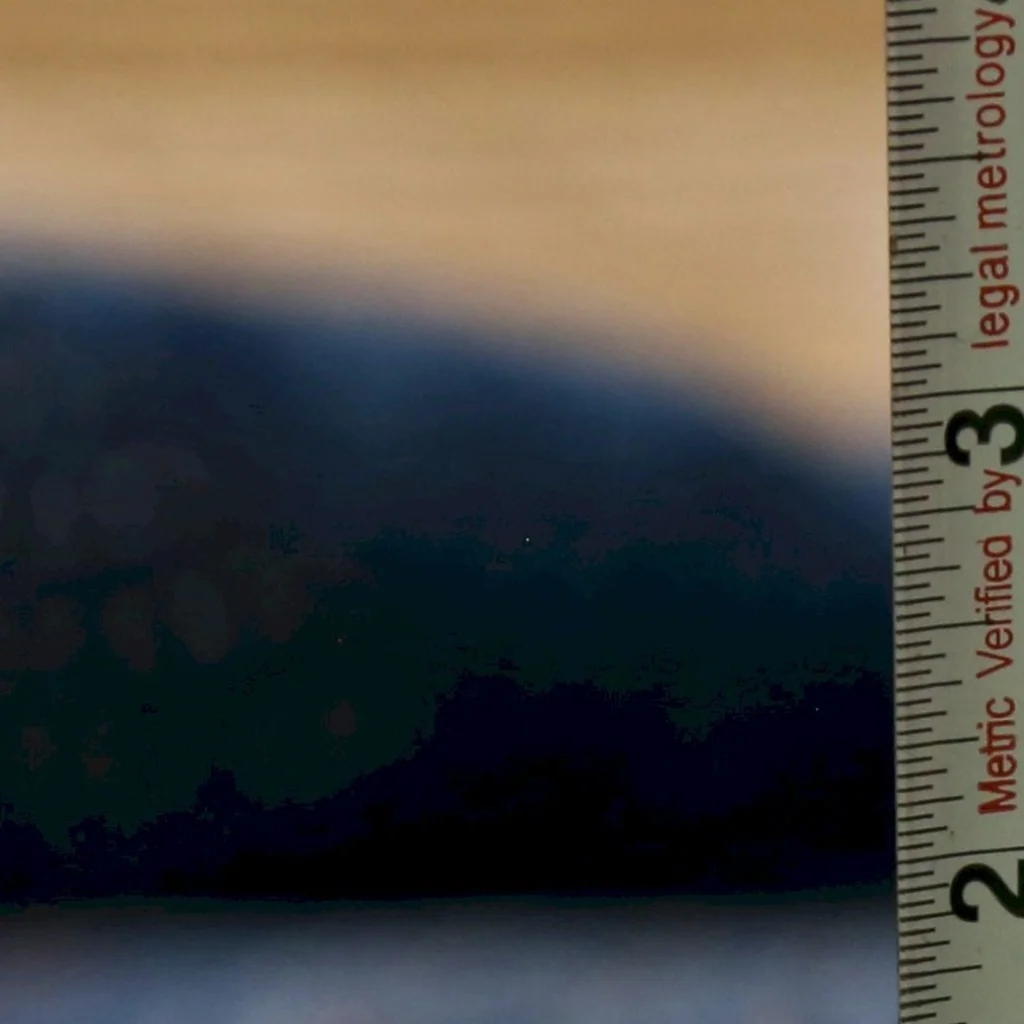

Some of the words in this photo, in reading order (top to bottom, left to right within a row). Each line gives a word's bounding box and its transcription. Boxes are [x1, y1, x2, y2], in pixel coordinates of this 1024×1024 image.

[965, 7, 1015, 230] metrology
[970, 243, 1020, 350] legal
[972, 468, 1022, 515] by
[973, 534, 1014, 679] Verified
[976, 696, 1018, 815] Metric
